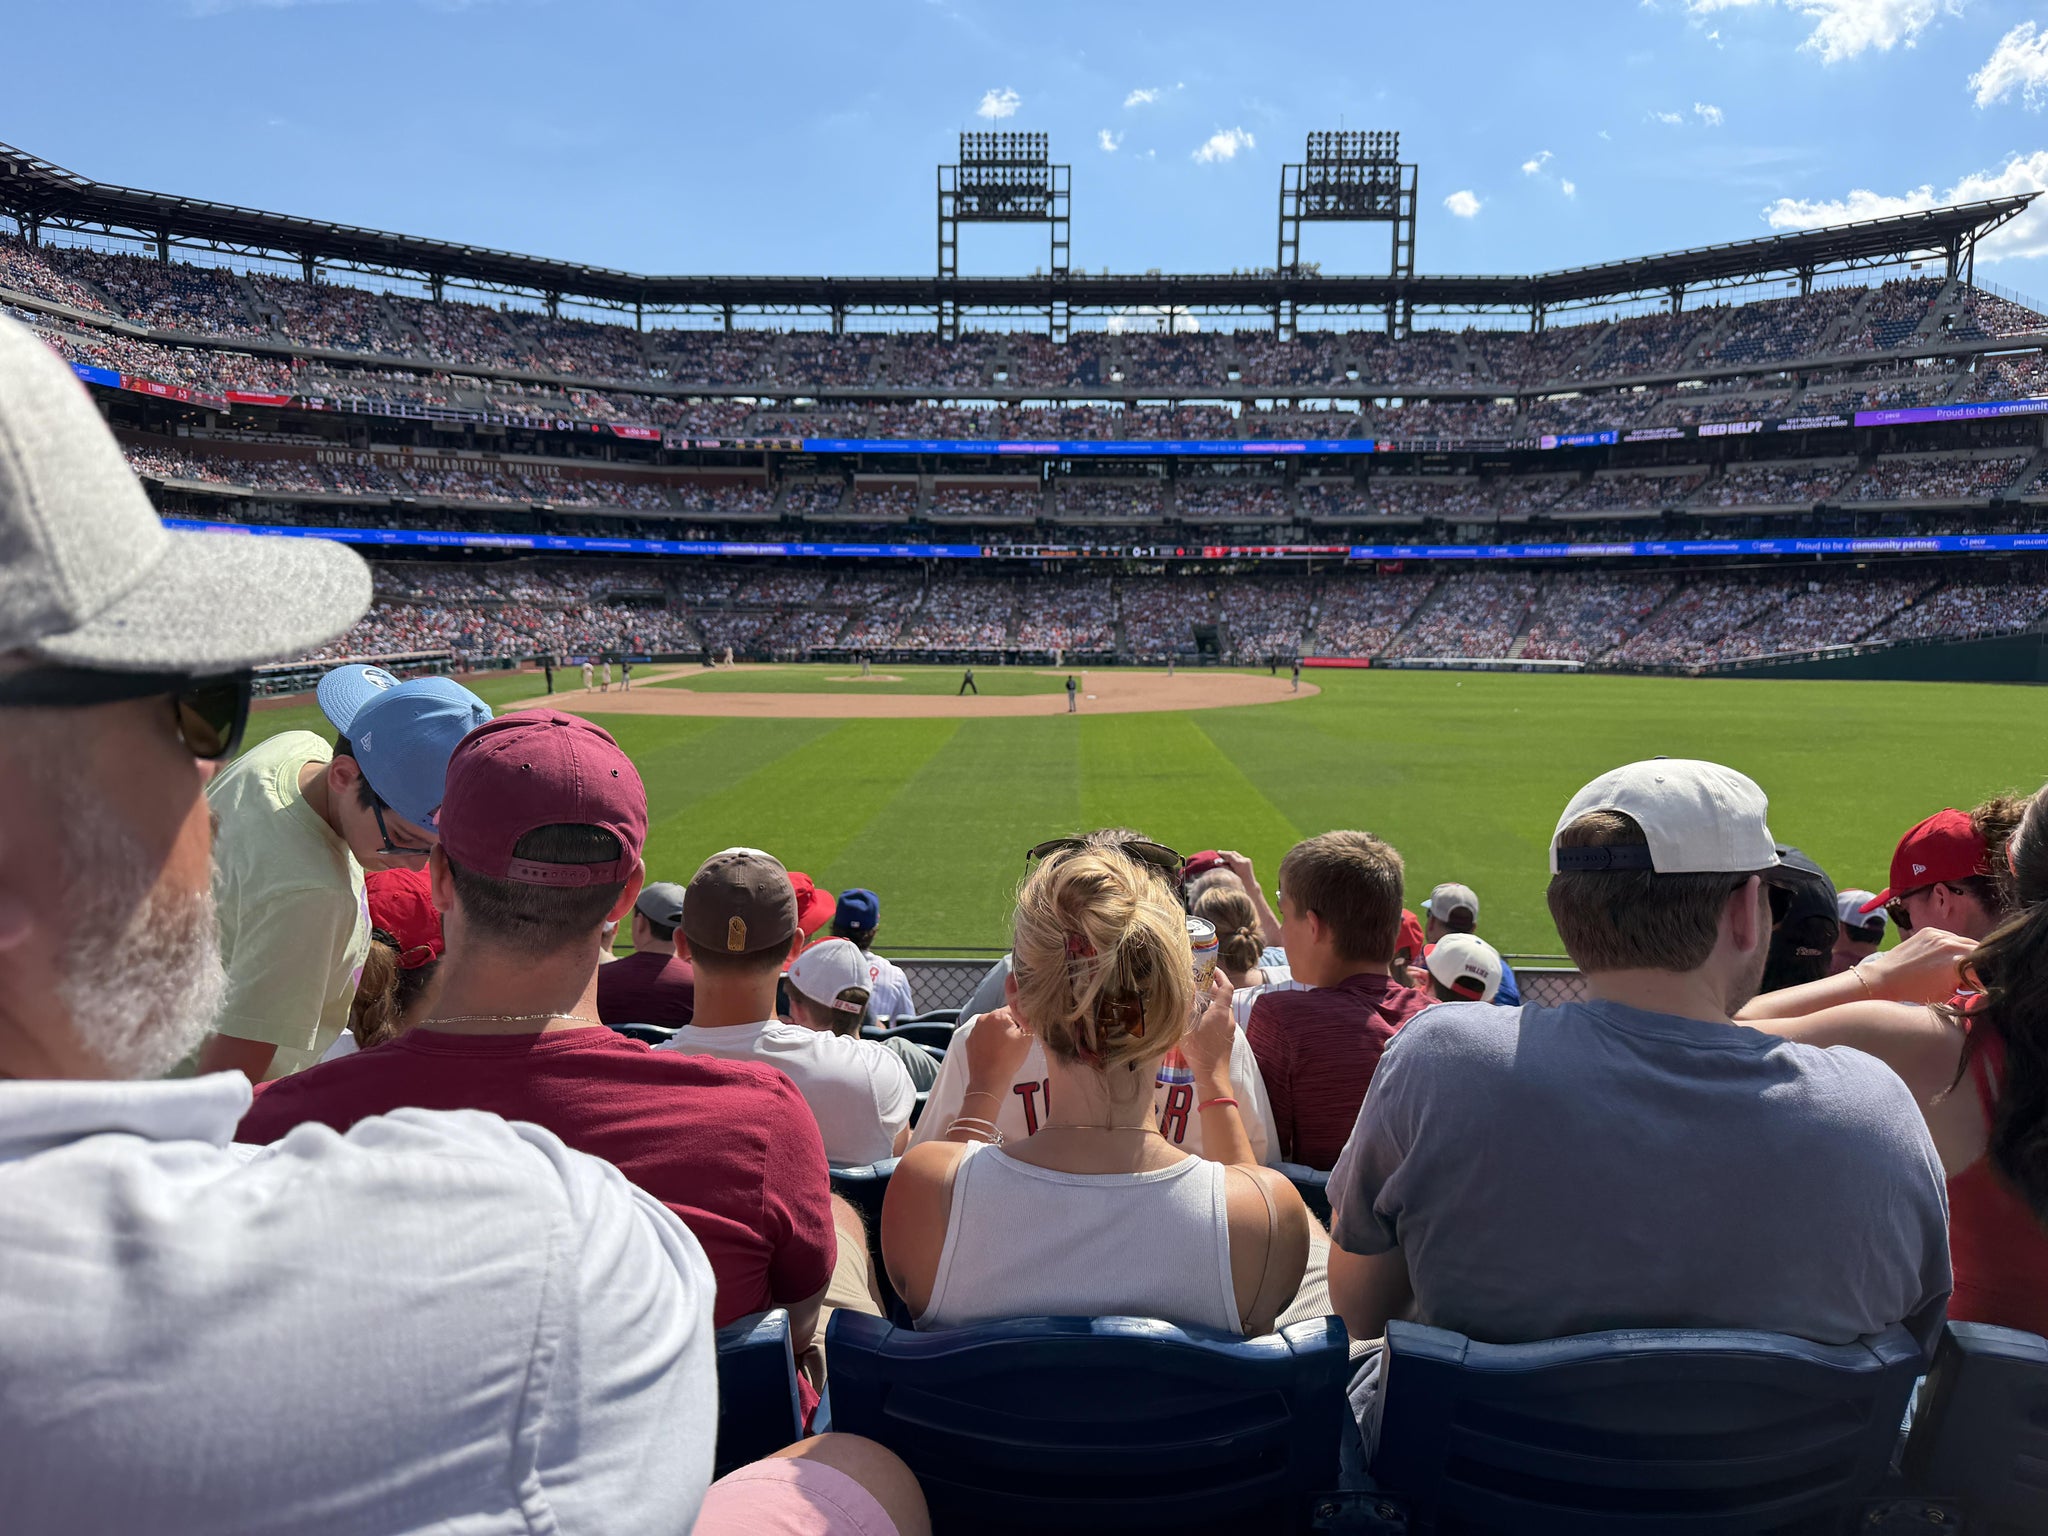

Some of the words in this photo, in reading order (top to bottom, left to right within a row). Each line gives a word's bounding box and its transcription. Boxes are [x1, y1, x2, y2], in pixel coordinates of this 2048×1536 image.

[1936, 406, 1964, 418] Proud
[1965, 406, 1975, 416] to
[1976, 405, 1986, 415] be
[1698, 424, 1728, 437] NEED
[1728, 421, 1763, 434] HELP?
[316, 450, 355, 465] HOME
[383, 454, 407, 469] THE
[413, 456, 502, 474] PHILADELPHIA
[508, 463, 560, 477] PHILLIES
[1132, 546, 1155, 558] 0-1
[1796, 541, 1821, 551] Proud
[1832, 541, 1843, 550] be
[1851, 540, 1901, 552] community
[1464, 964, 1489, 979] PHILLIES
